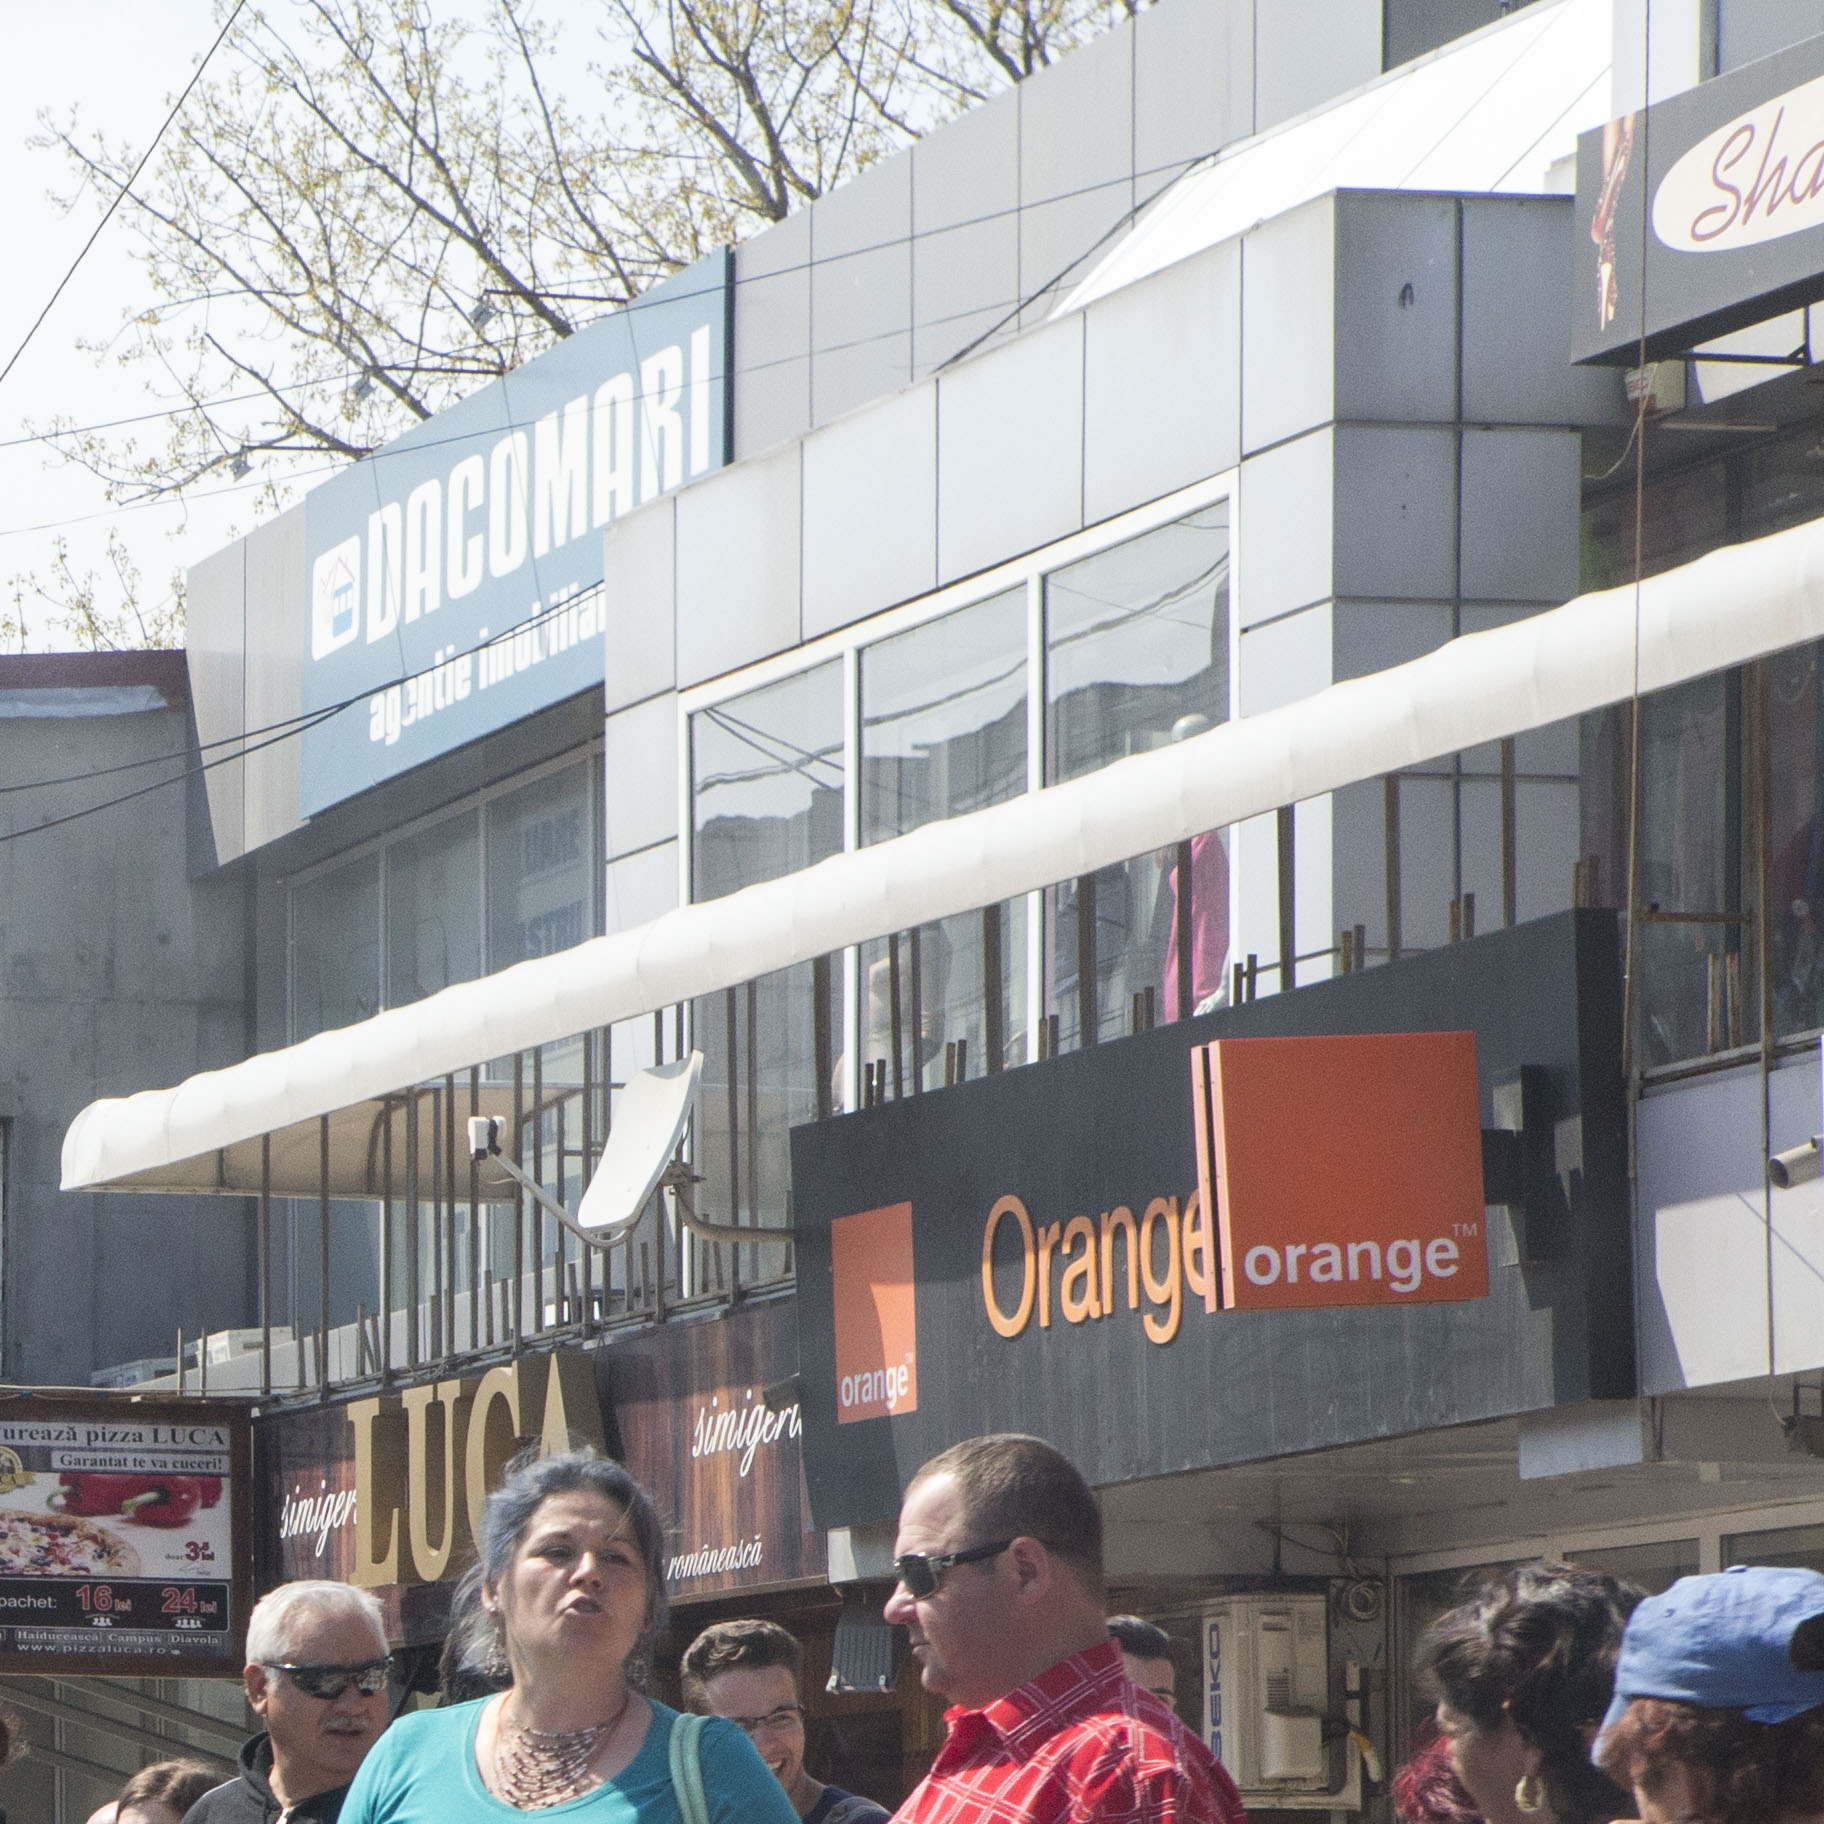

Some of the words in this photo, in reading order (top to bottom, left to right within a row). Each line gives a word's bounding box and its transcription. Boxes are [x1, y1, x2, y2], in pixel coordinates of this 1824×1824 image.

[366, 322, 711, 646] DACOMARI
[1243, 1235, 1460, 1294] orange
[840, 1364, 909, 1410] orange
[86, 1427, 143, 1446] pizza
[153, 1428, 224, 1446] LUCA
[59, 1454, 128, 1468] Garantat
[132, 1456, 145, 1468] te
[151, 1458, 167, 1468] va
[172, 1458, 223, 1470] cuceri!
[666, 1533, 763, 1581] românească
[75, 1584, 113, 1611] 16
[161, 1587, 198, 1613] 24
